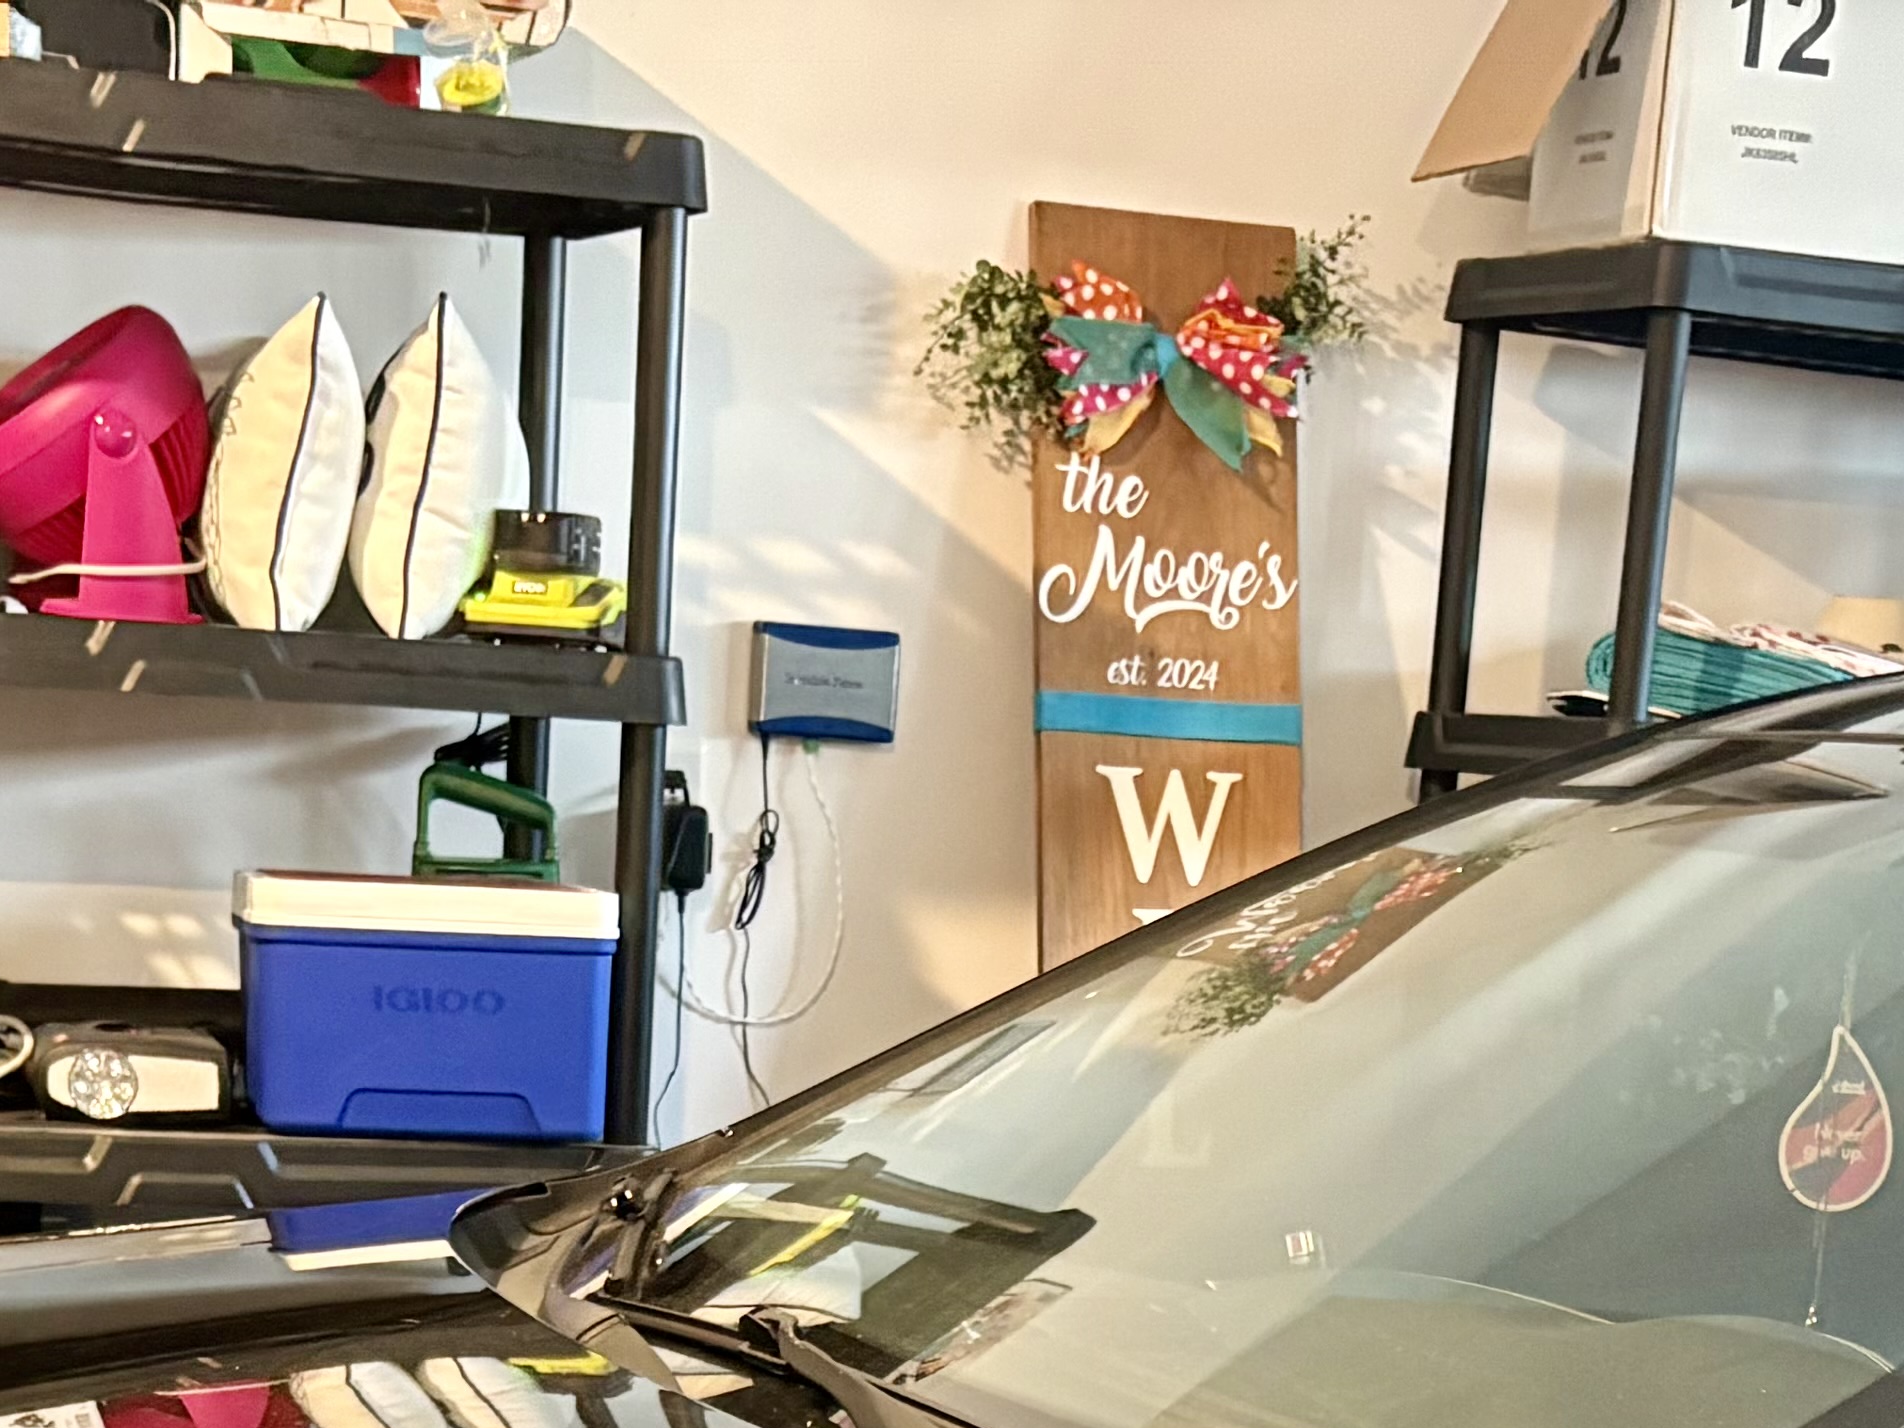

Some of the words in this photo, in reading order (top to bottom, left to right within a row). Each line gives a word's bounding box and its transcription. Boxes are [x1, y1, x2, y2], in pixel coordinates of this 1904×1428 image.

[1055, 451, 1149, 518] the
[1038, 524, 1298, 634] Moore's
[1107, 655, 1147, 686] est.
[1158, 658, 1219, 691] 2024
